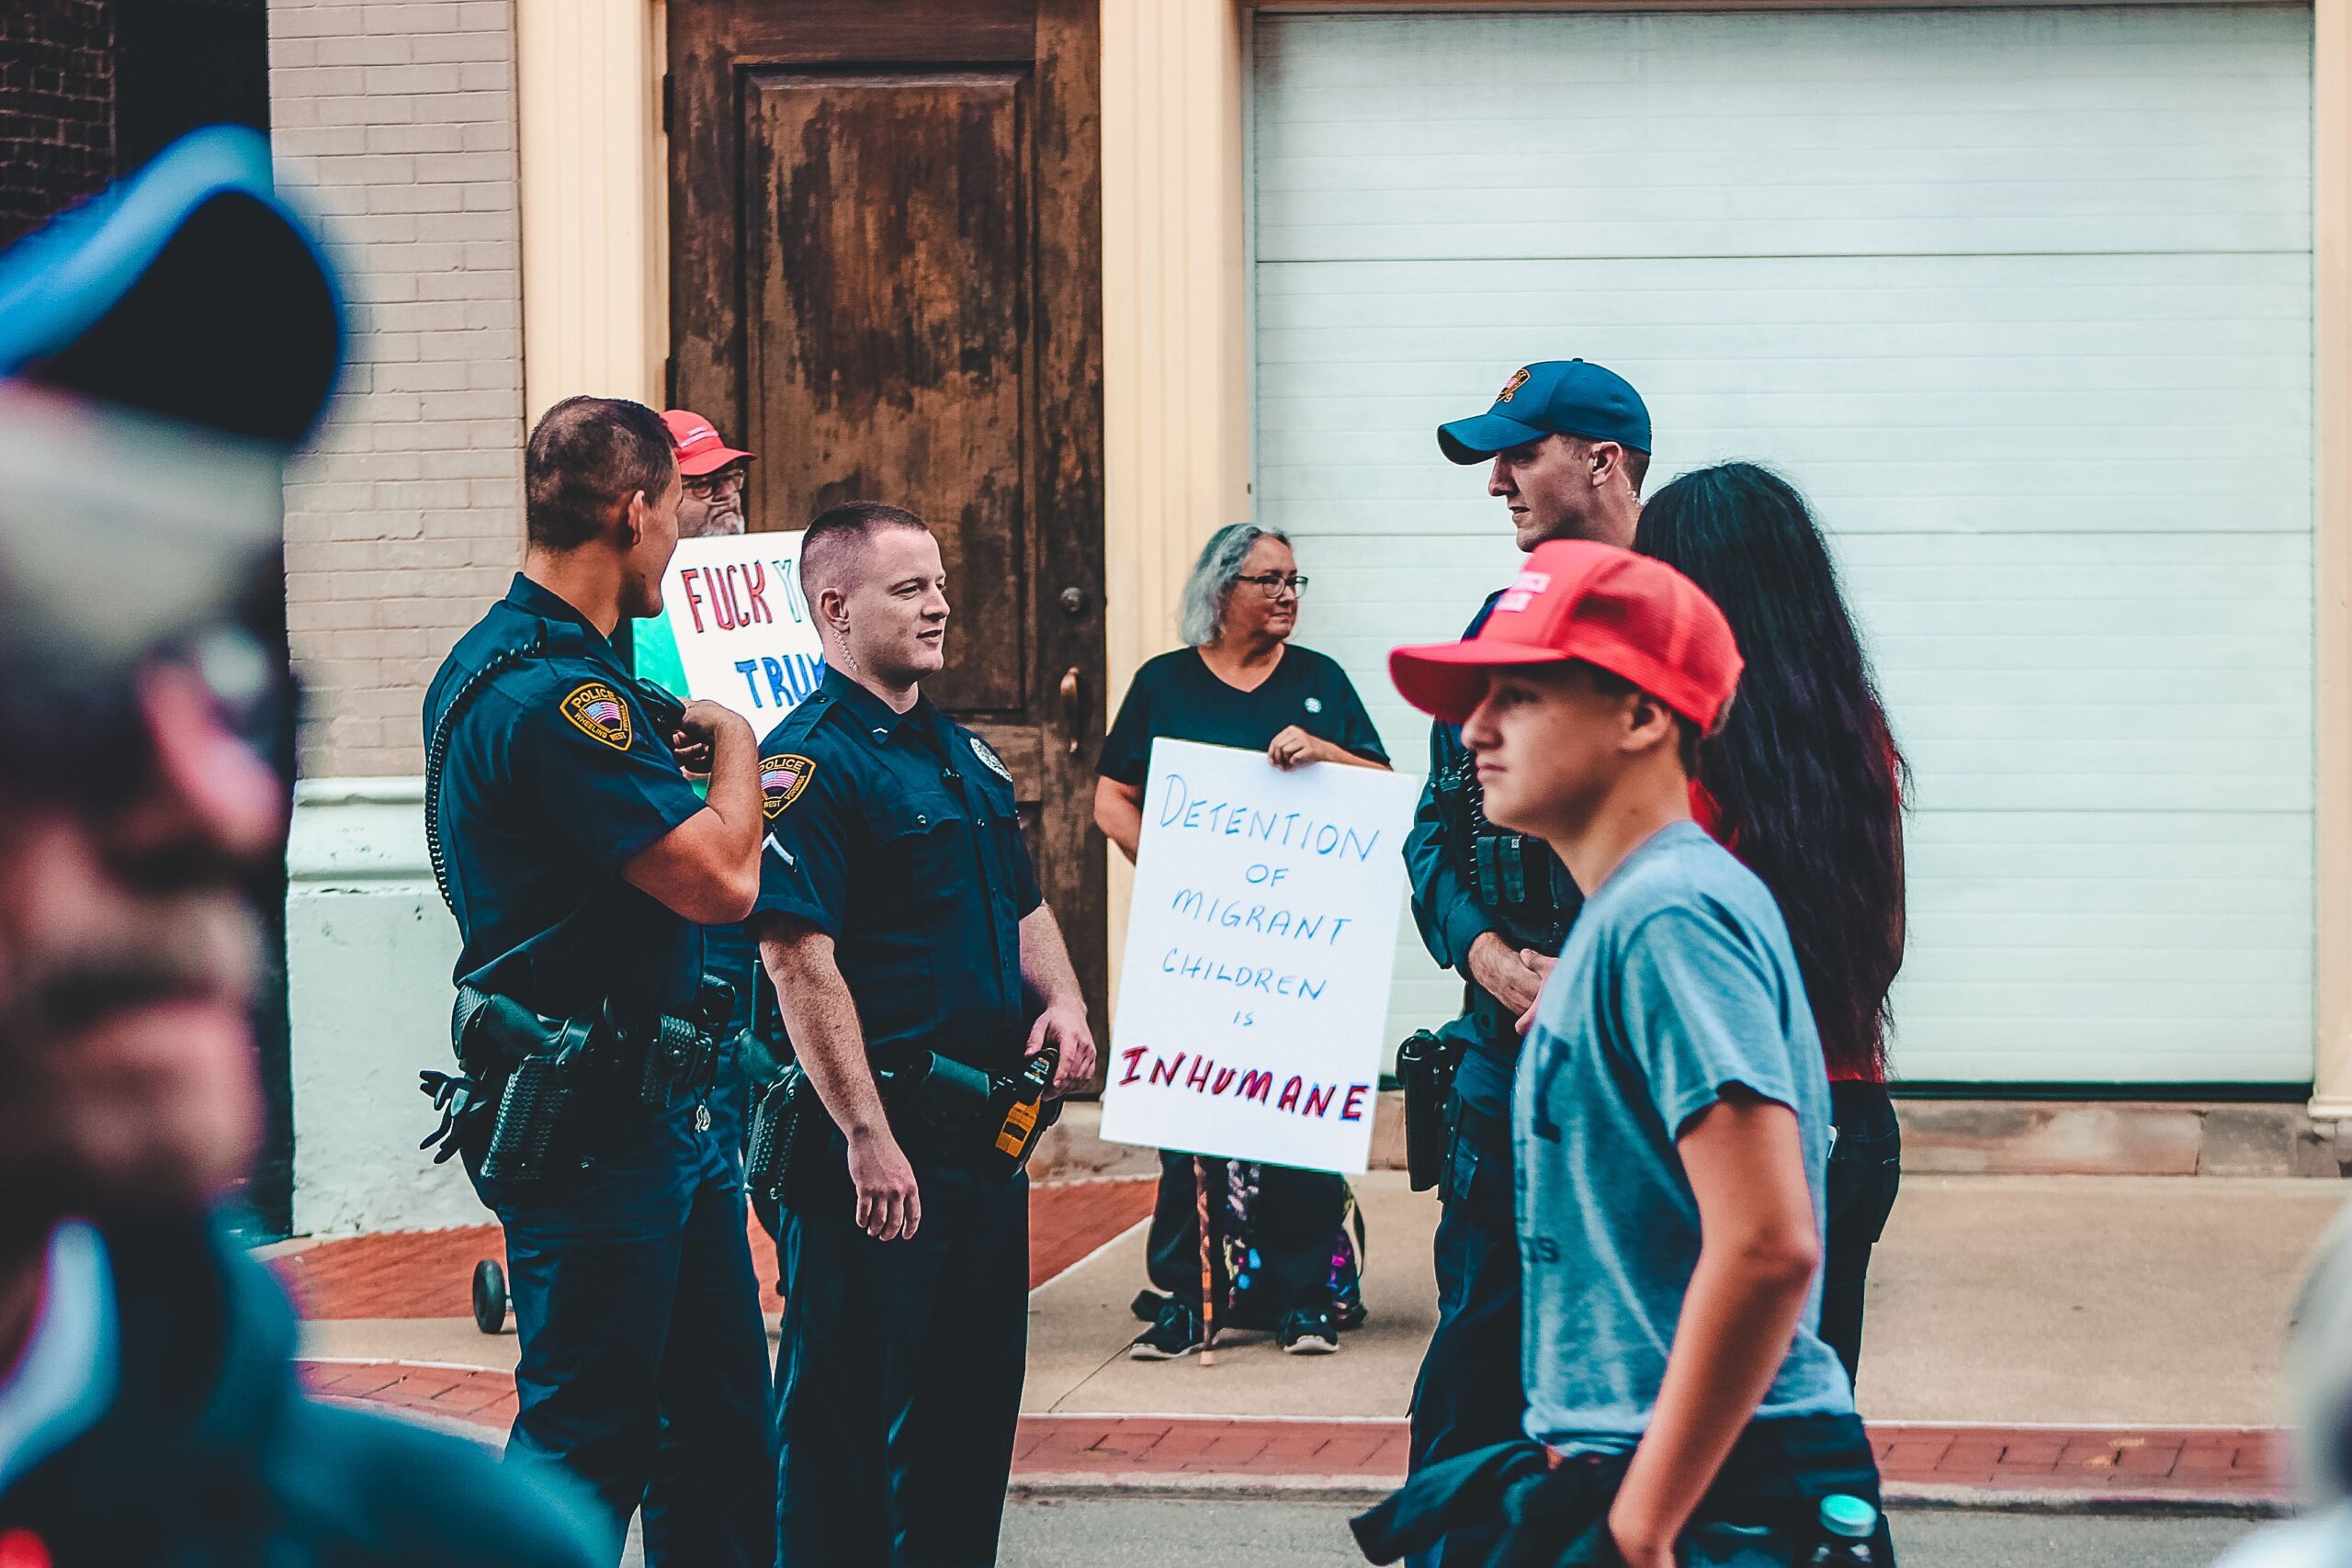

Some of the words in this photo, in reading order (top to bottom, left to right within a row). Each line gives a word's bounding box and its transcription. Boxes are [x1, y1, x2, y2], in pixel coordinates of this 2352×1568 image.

[680, 559, 773, 634] FUCK
[772, 558, 809, 623] Y
[571, 688, 618, 708] POLICE
[574, 712, 607, 739] WHEELING
[1159, 773, 1381, 863] DETENTION
[1245, 863, 1289, 888] OF
[1171, 888, 1352, 947] MIGRANT
[1161, 947, 1328, 1001] CHILDREN
[1233, 1010, 1255, 1027] IS
[1117, 1044, 1371, 1122] INHUMANE
